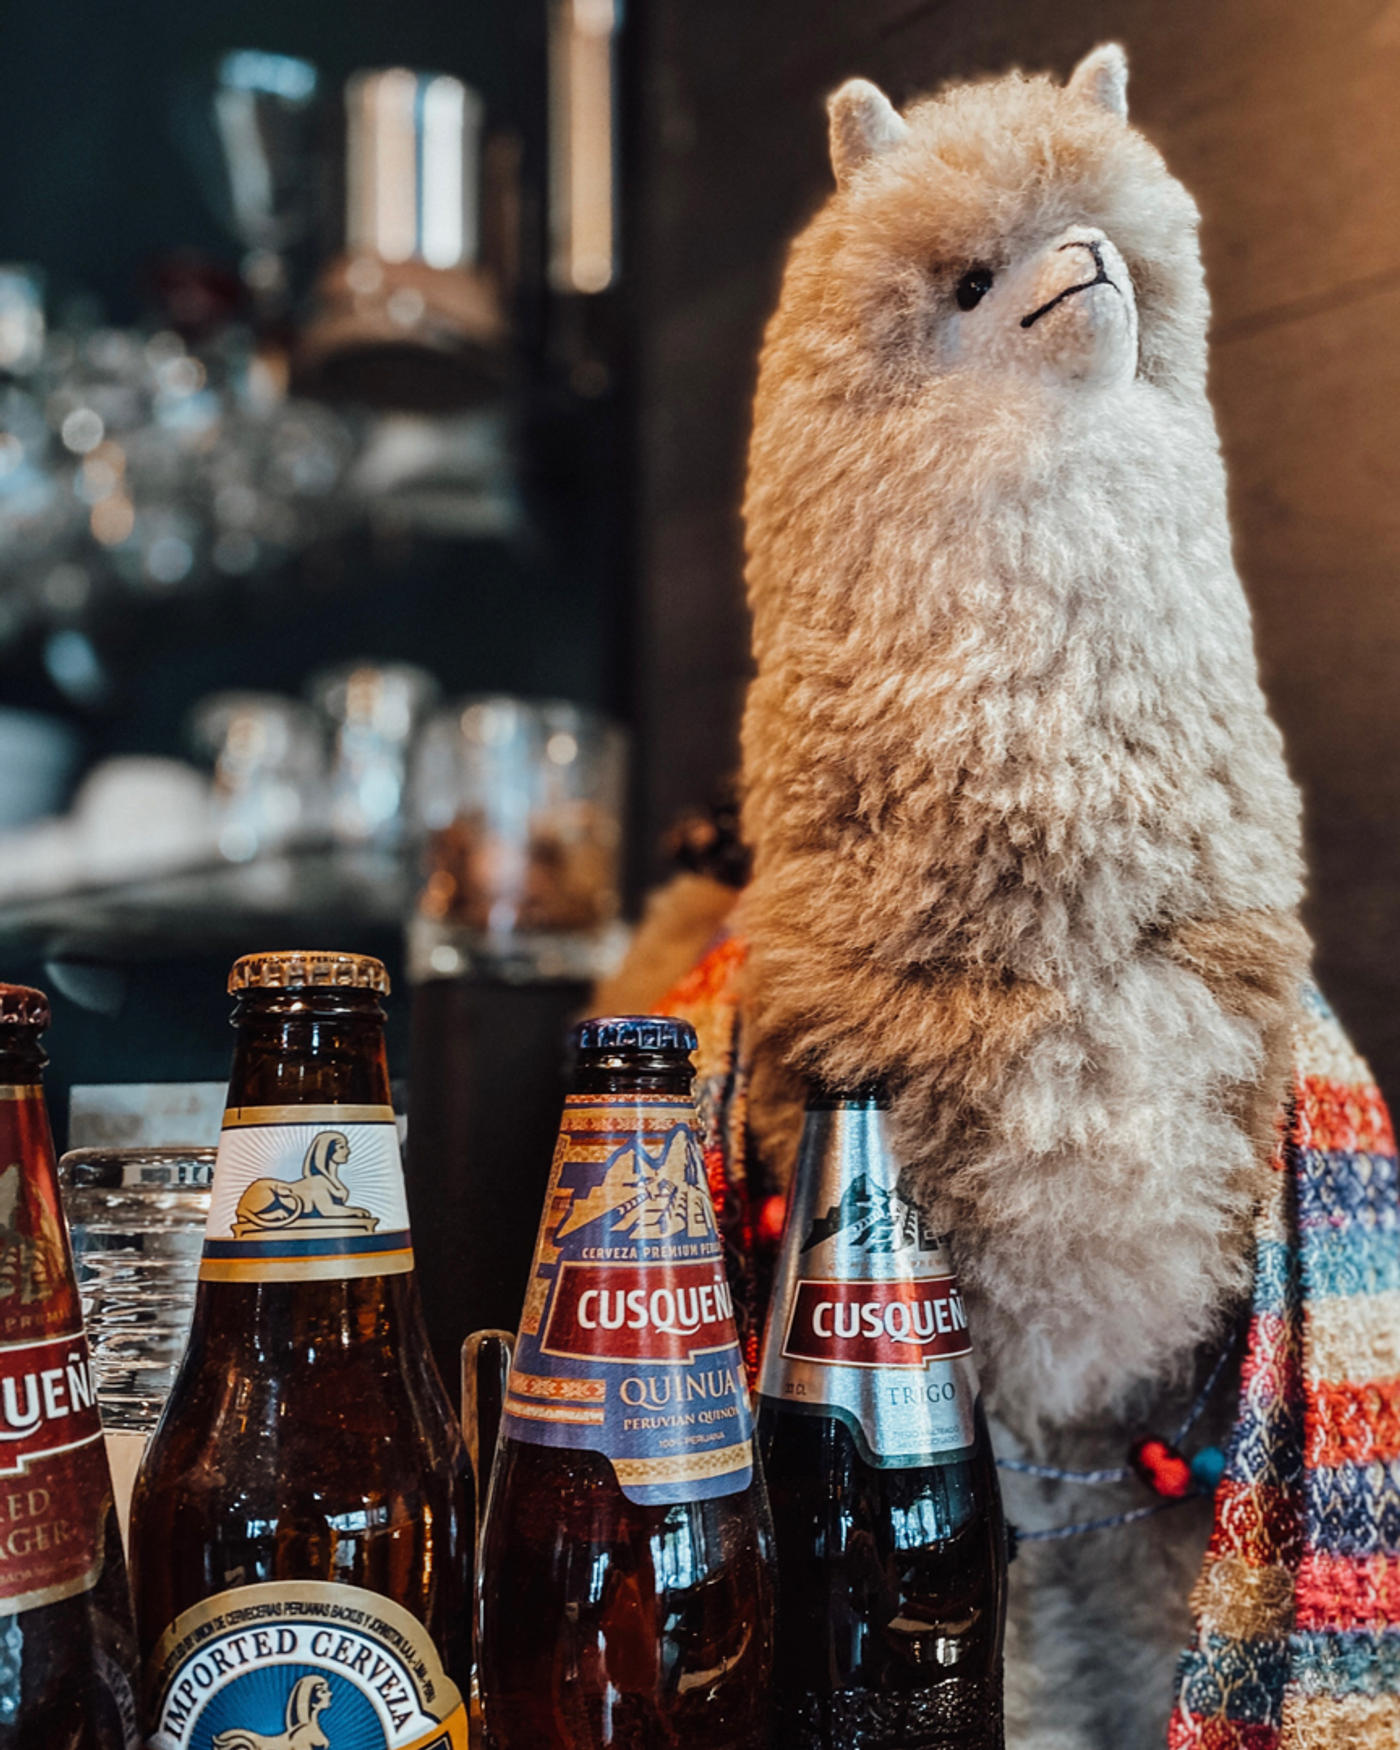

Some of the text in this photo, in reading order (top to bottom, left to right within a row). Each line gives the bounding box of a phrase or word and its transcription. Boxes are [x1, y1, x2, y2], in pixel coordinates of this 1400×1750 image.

[582, 1247, 638, 1259] CERVEZA
[643, 1245, 699, 1258] PREMIUM
[812, 1288, 968, 1345] CUSQUEÑ
[619, 1368, 738, 1411] QUINUA
[886, 1382, 956, 1406] TRIGO
[623, 1413, 696, 1431] PERUVIAN
[0, 1488, 51, 1522] ED
[163, 1628, 299, 1743] IMPORTED
[310, 1630, 413, 1734] CERVEZA
